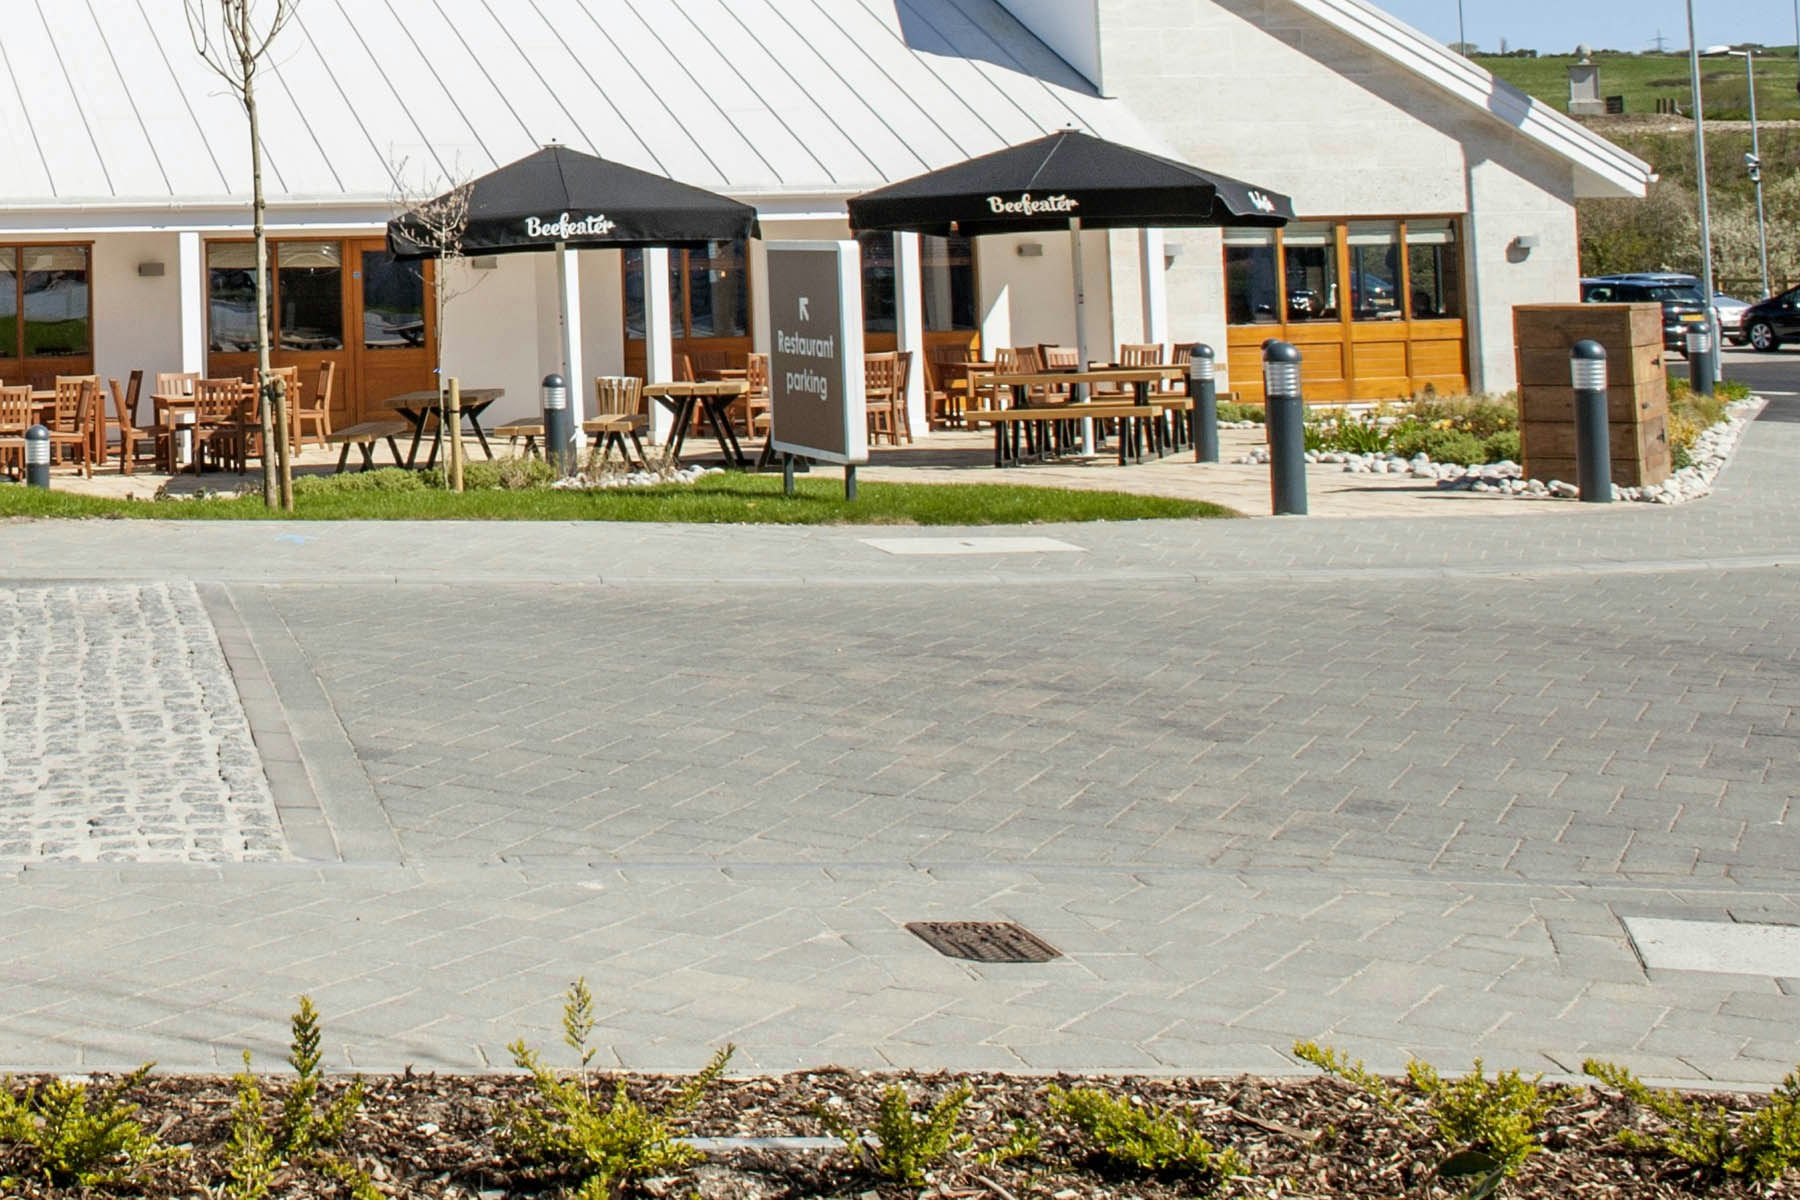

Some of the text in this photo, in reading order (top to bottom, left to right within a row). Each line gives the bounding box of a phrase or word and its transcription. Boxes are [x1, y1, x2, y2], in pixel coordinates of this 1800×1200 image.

[987, 193, 1079, 216] Beefeater
[525, 212, 616, 239] Beefeater
[777, 330, 834, 359] Restaurant
[786, 369, 828, 401] parking
